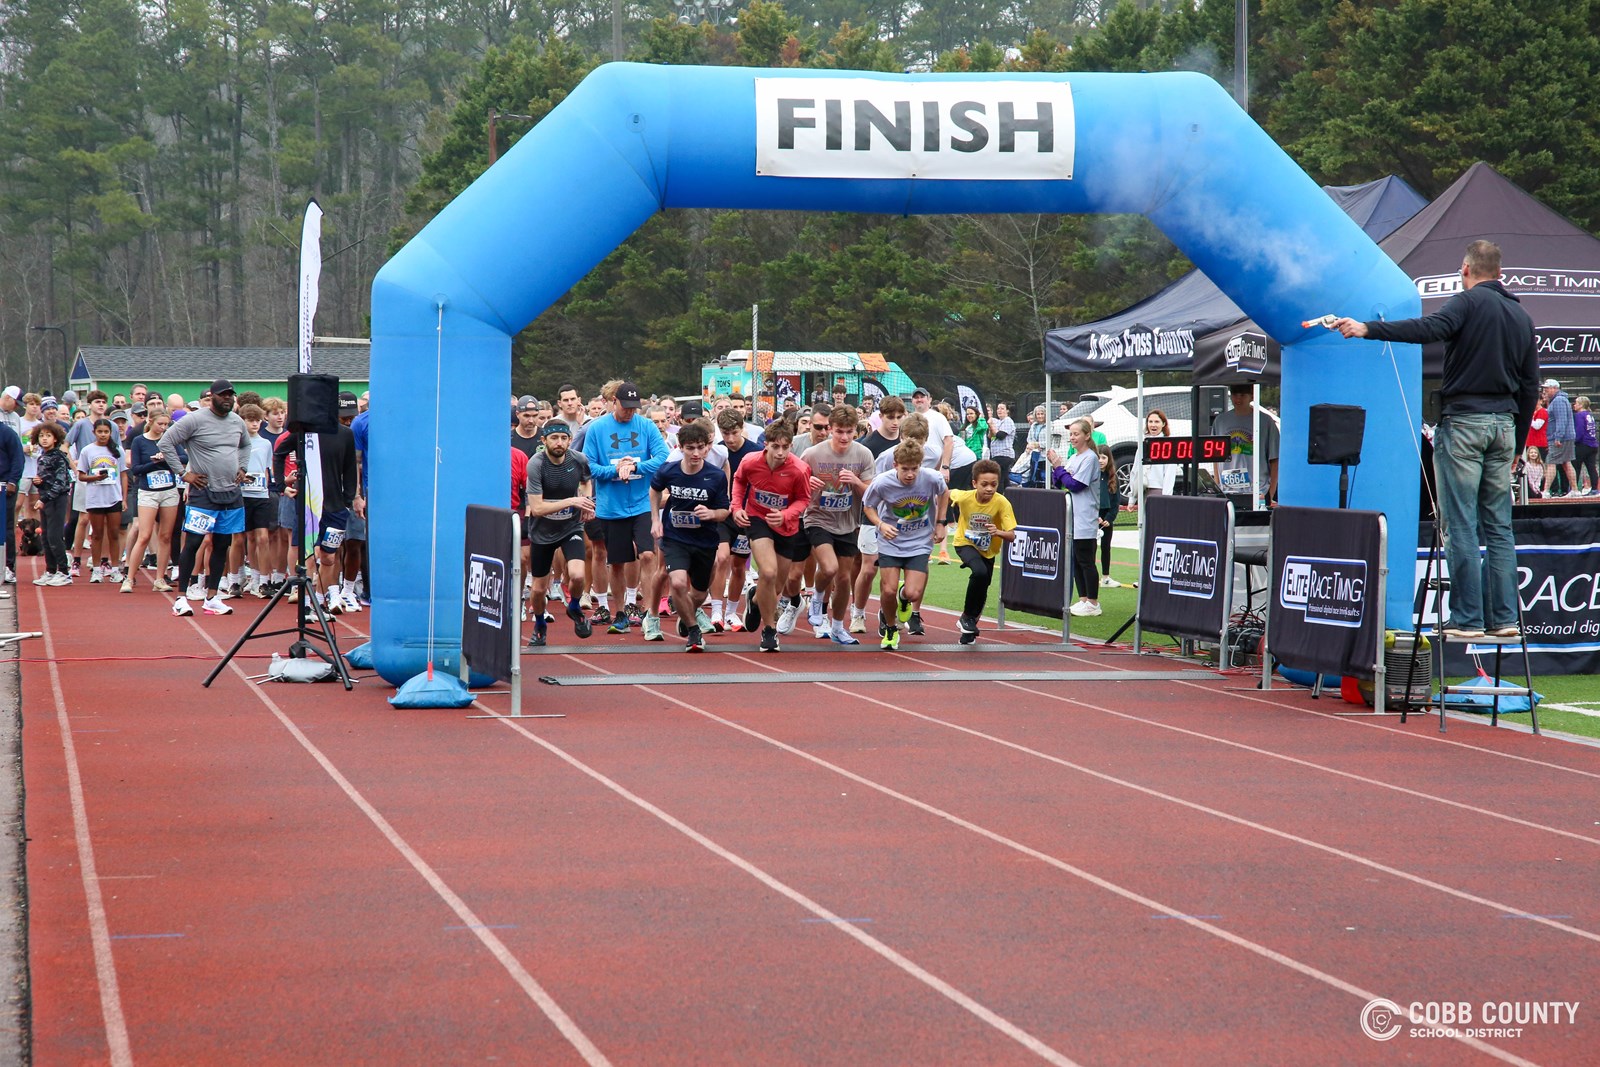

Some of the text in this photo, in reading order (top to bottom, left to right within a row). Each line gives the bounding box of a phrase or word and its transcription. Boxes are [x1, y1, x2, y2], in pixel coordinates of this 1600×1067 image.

[777, 97, 1054, 153] FINISH
[1424, 280, 1463, 293] ELI
[1123, 328, 1152, 357] Cross
[1152, 327, 1195, 358] Country
[717, 379, 731, 388] TOM'S
[1204, 440, 1226, 458] 94
[151, 474, 170, 486] 5391
[1224, 473, 1247, 486] 5664
[759, 494, 784, 507] 5788
[824, 497, 849, 508] 5789
[189, 514, 212, 531] 5497
[671, 514, 697, 525] 5641
[1174, 549, 1192, 575] RACE
[1287, 568, 1309, 597] ELITE
[1310, 570, 1333, 600] RACE
